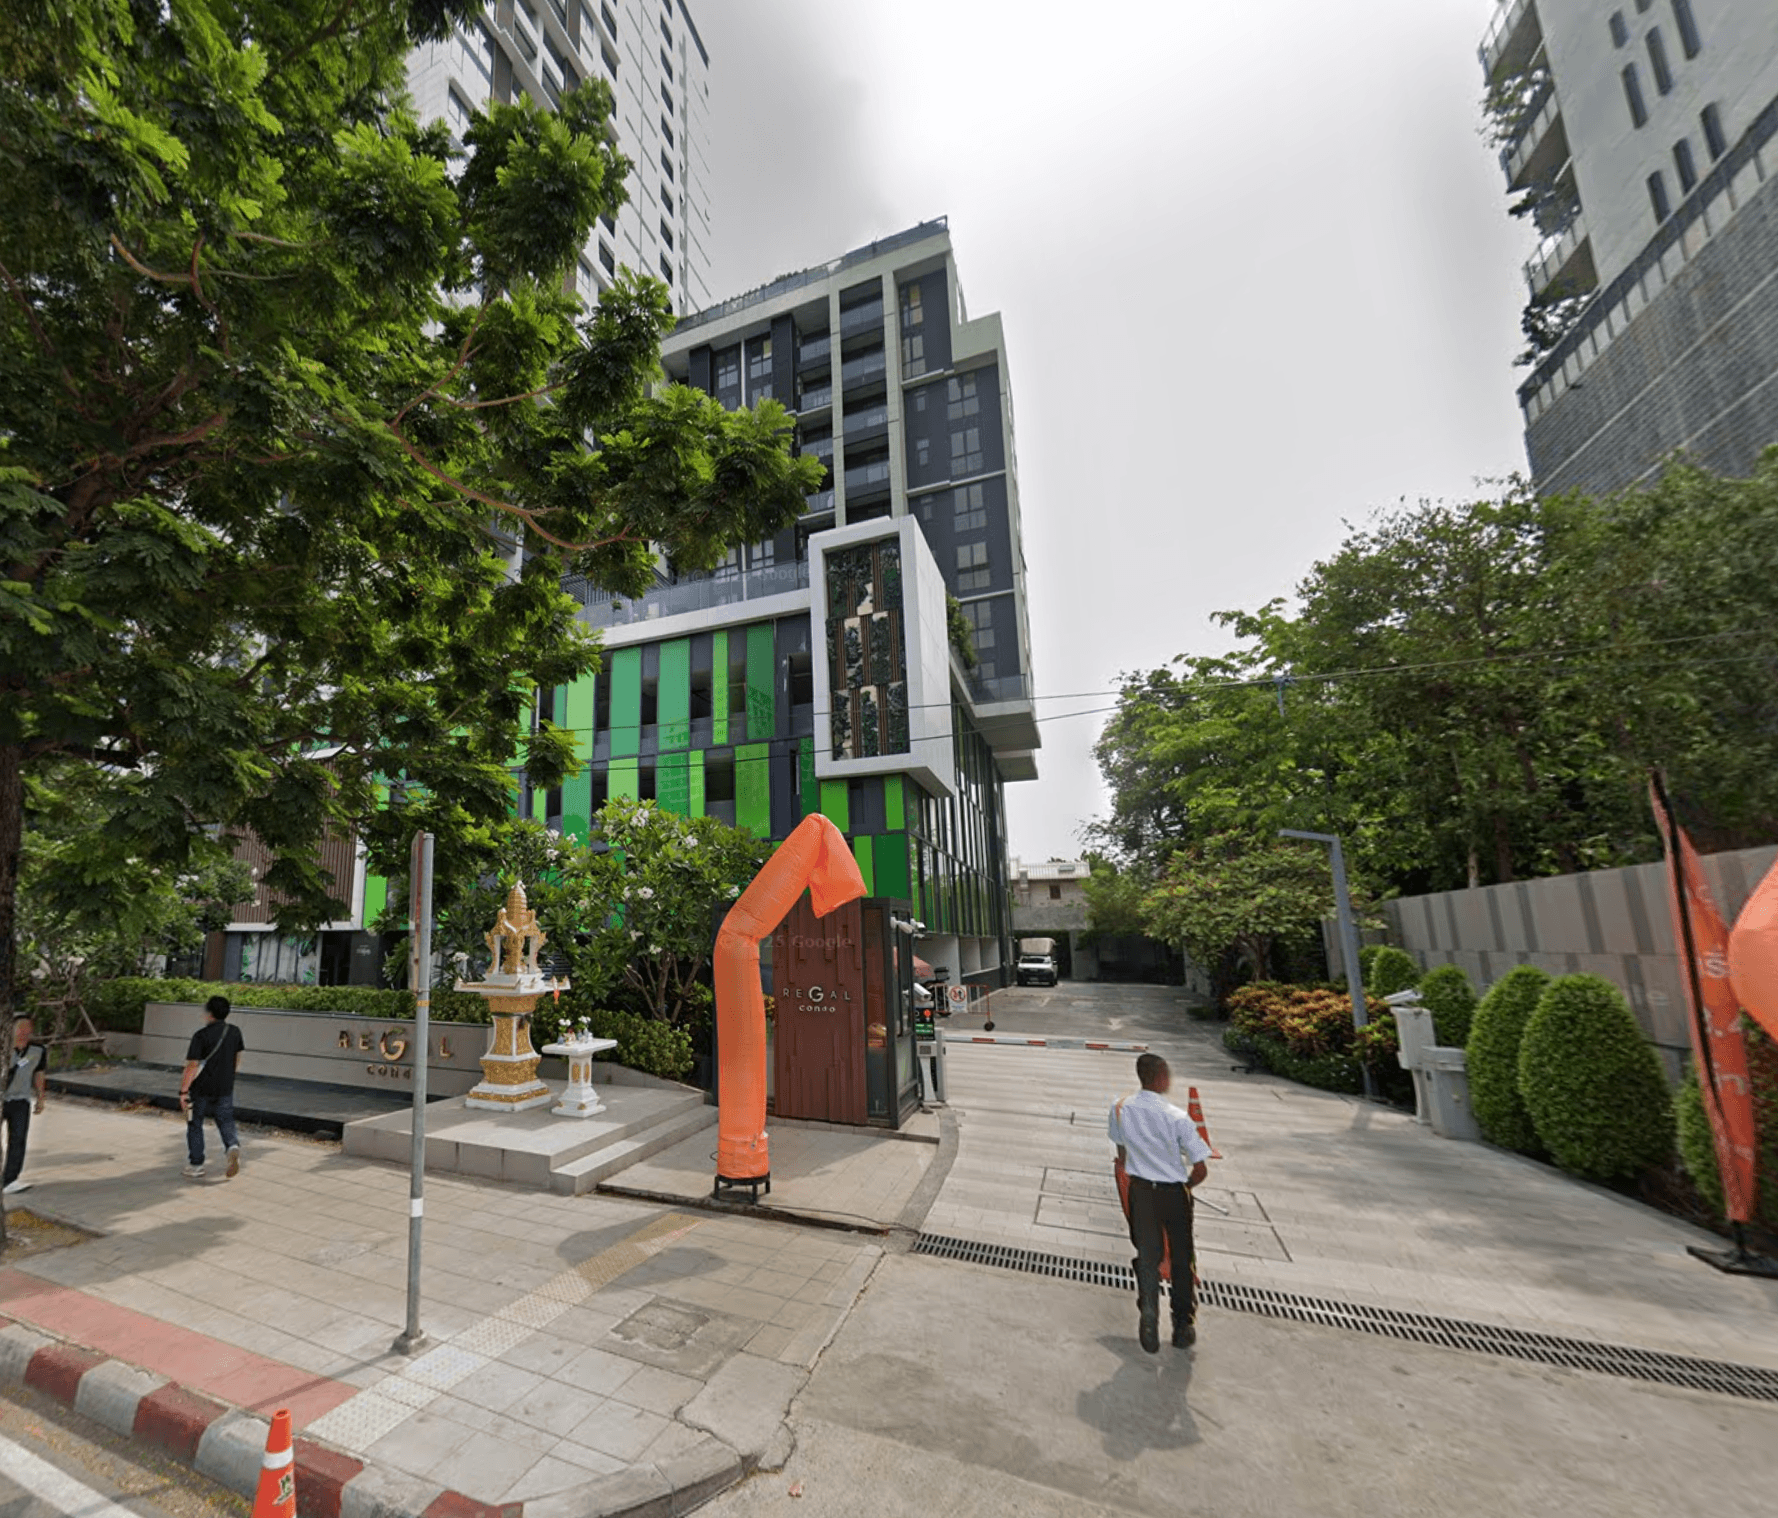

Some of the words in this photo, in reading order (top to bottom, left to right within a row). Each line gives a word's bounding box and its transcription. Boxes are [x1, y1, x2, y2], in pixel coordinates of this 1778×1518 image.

[783, 986, 851, 1003] REGAL
[338, 1026, 451, 1061] REGL
[366, 1063, 413, 1080] cond
